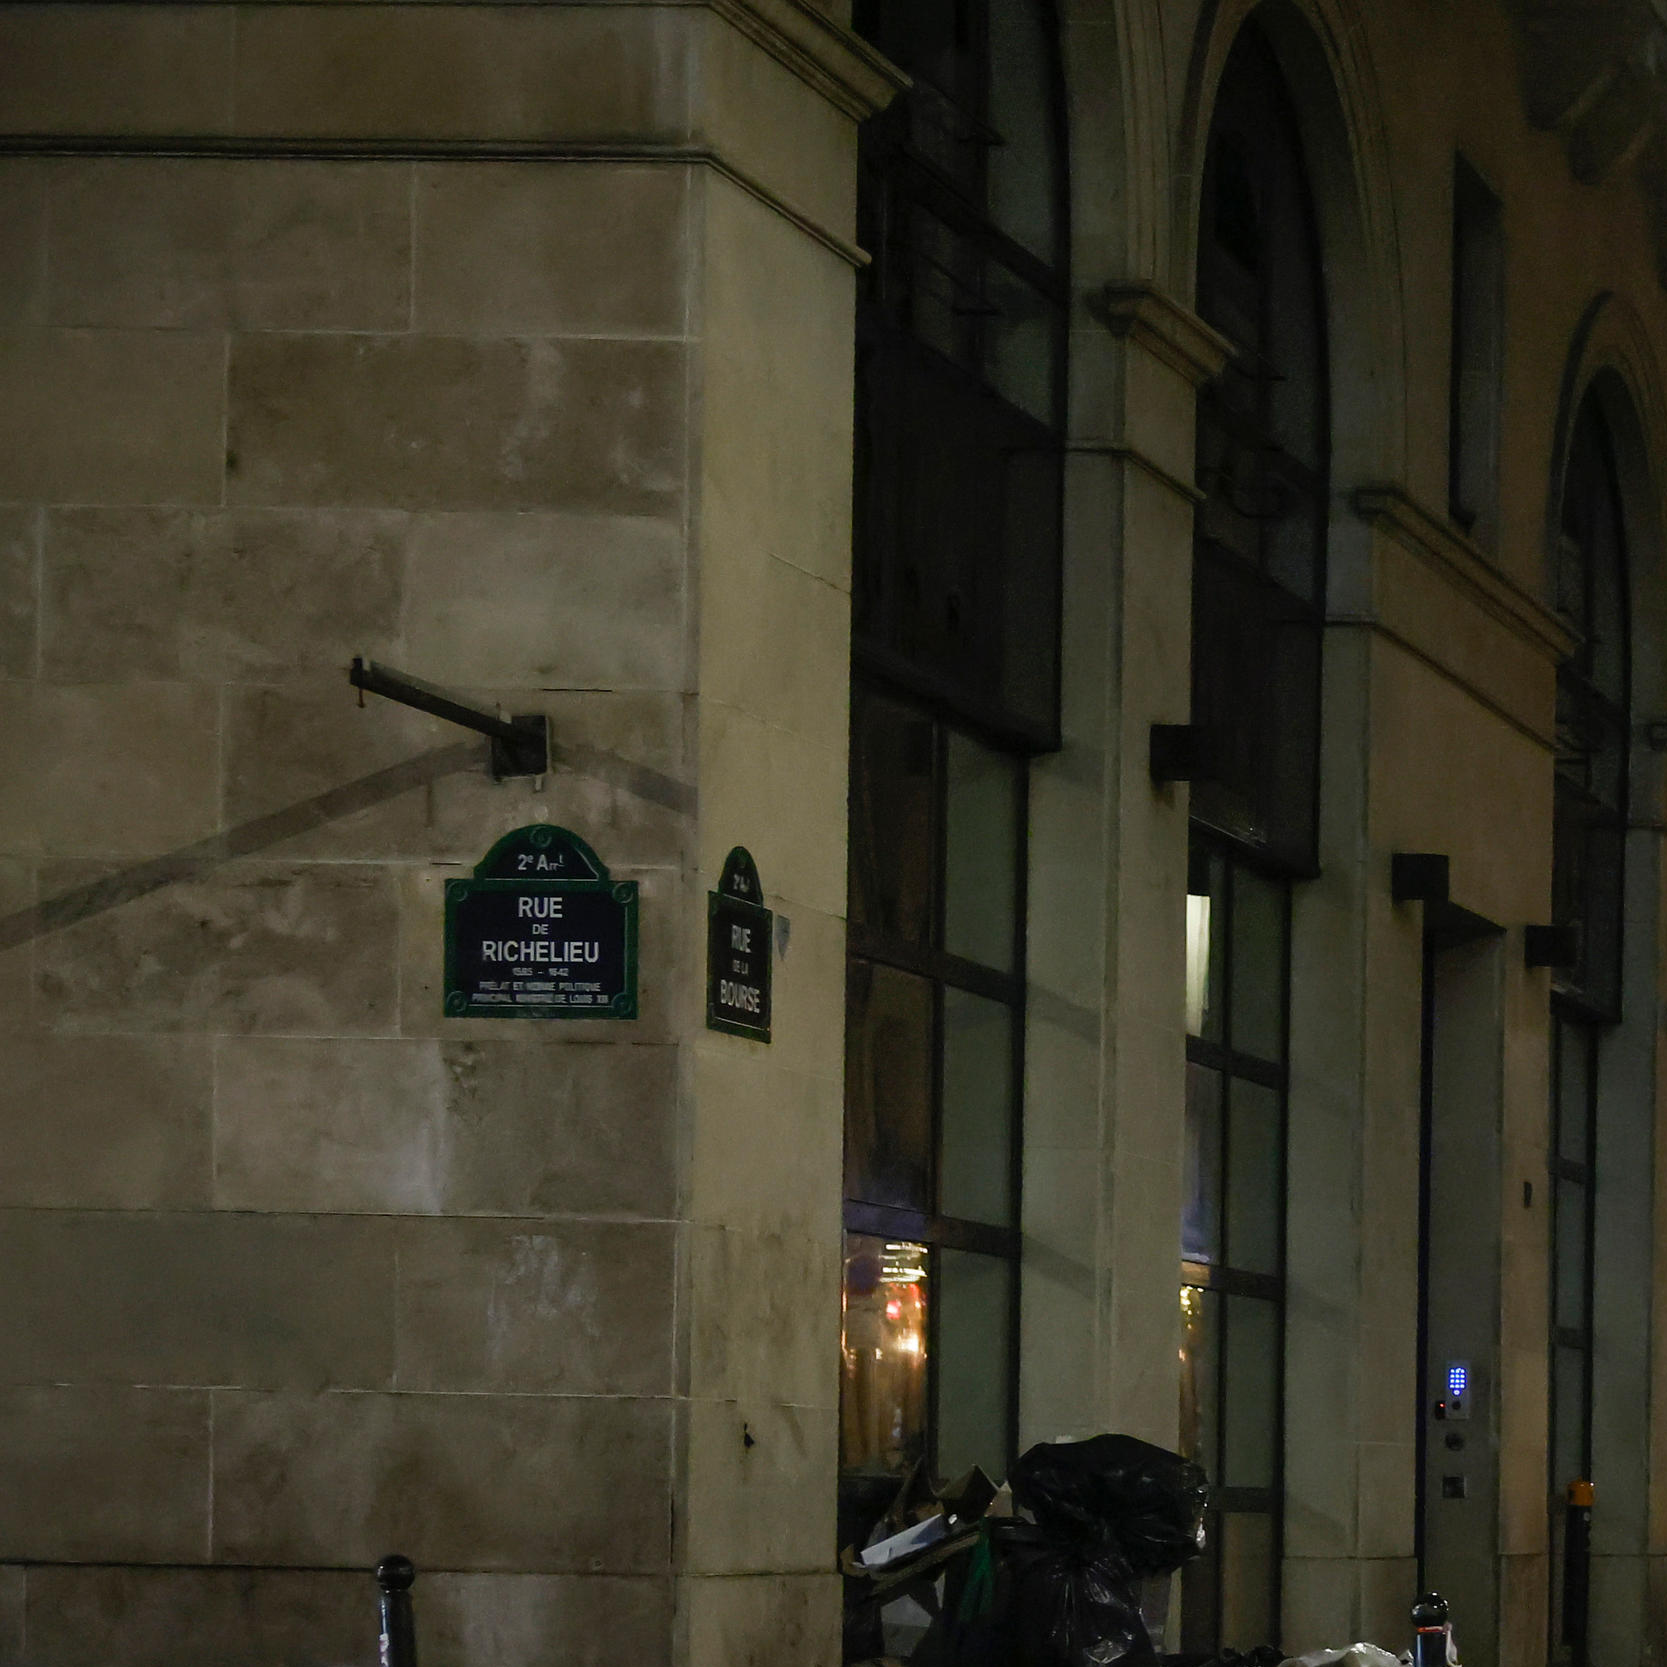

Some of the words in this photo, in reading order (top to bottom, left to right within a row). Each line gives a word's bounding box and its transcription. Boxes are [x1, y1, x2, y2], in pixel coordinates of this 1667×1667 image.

[518, 896, 563, 918] RUE
[532, 923, 549, 935] DE
[731, 924, 752, 954] RUE
[482, 940, 600, 963] RICHELIEU
[720, 978, 761, 1014] BOURSE
